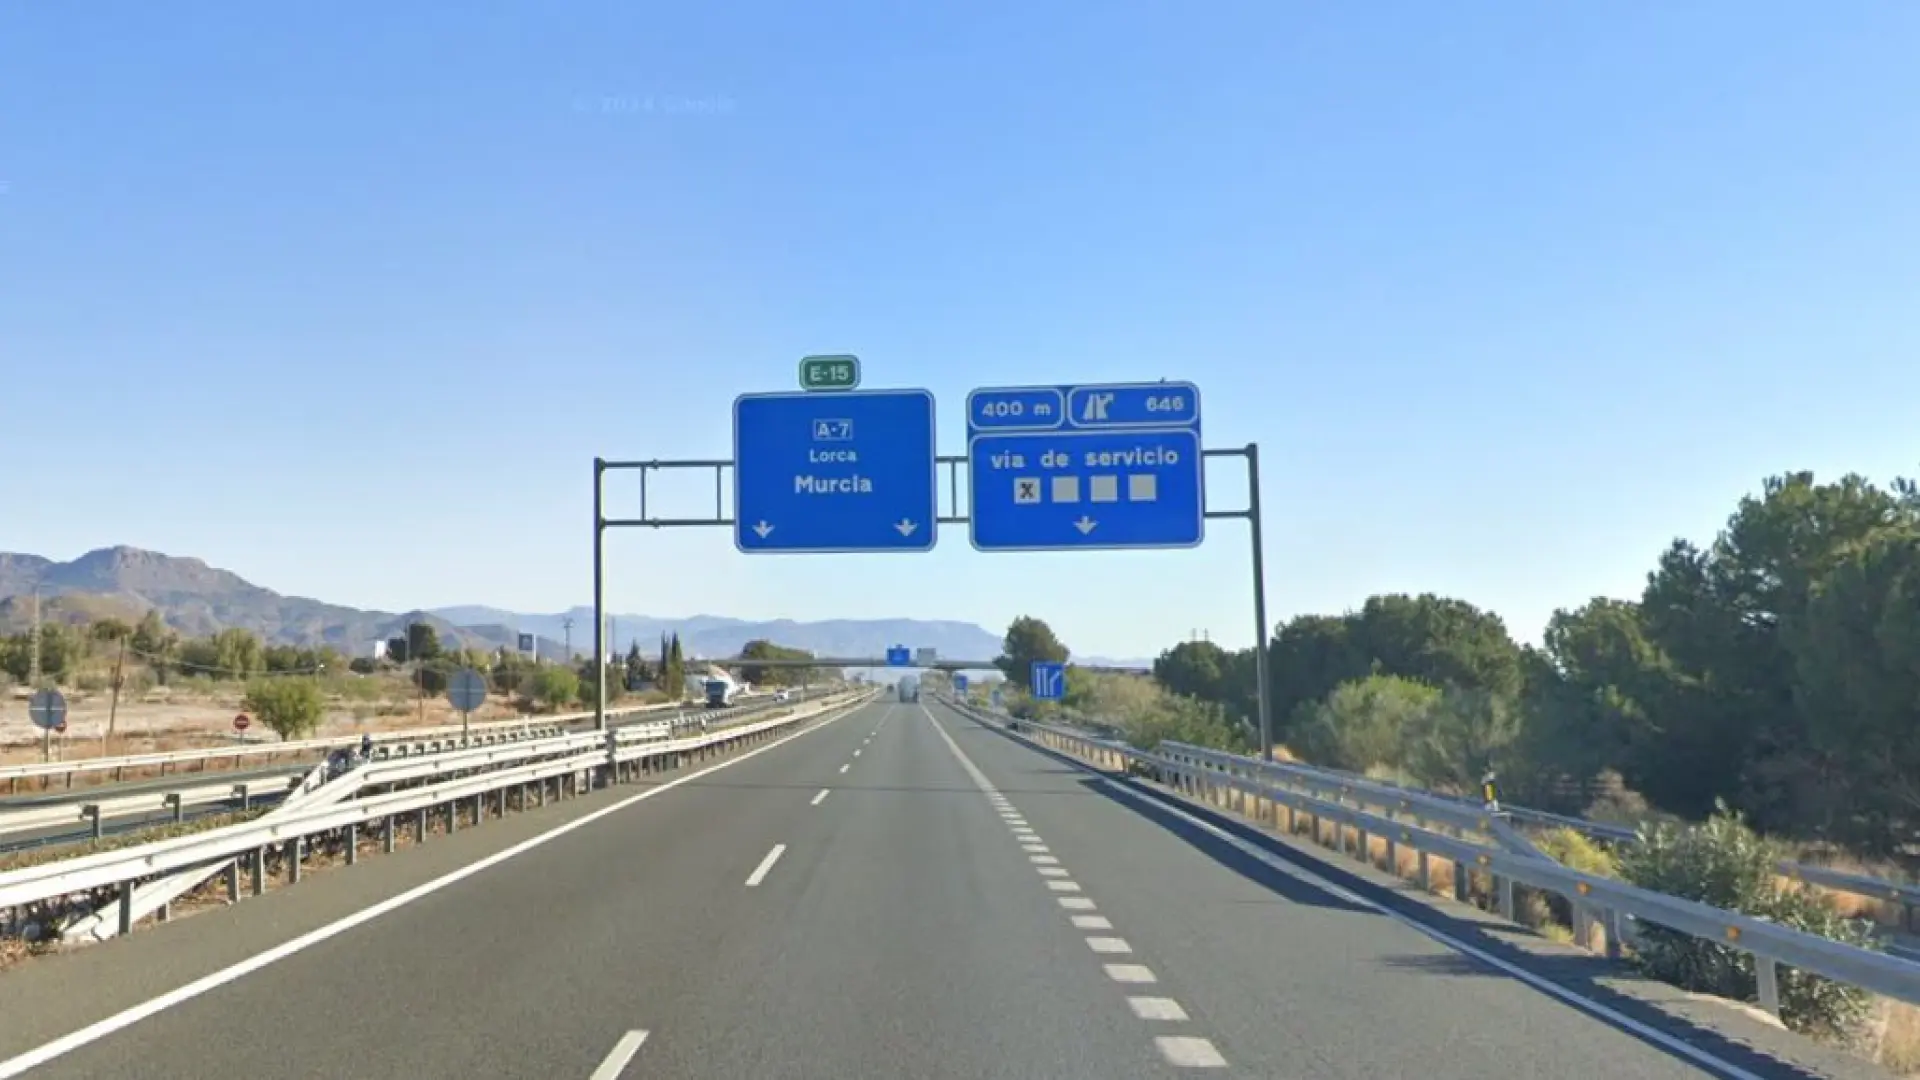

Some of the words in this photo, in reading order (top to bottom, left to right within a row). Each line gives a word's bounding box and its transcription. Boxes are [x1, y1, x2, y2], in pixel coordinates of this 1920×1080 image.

[809, 365, 849, 382] E-15
[981, 401, 1023, 417] 400
[1033, 403, 1051, 416] m
[1146, 396, 1185, 412] 646
[817, 422, 849, 436] A-7
[809, 448, 857, 463] Lorca
[1039, 448, 1069, 468] de
[1084, 445, 1180, 466] servicio
[794, 474, 873, 494] Murcia
